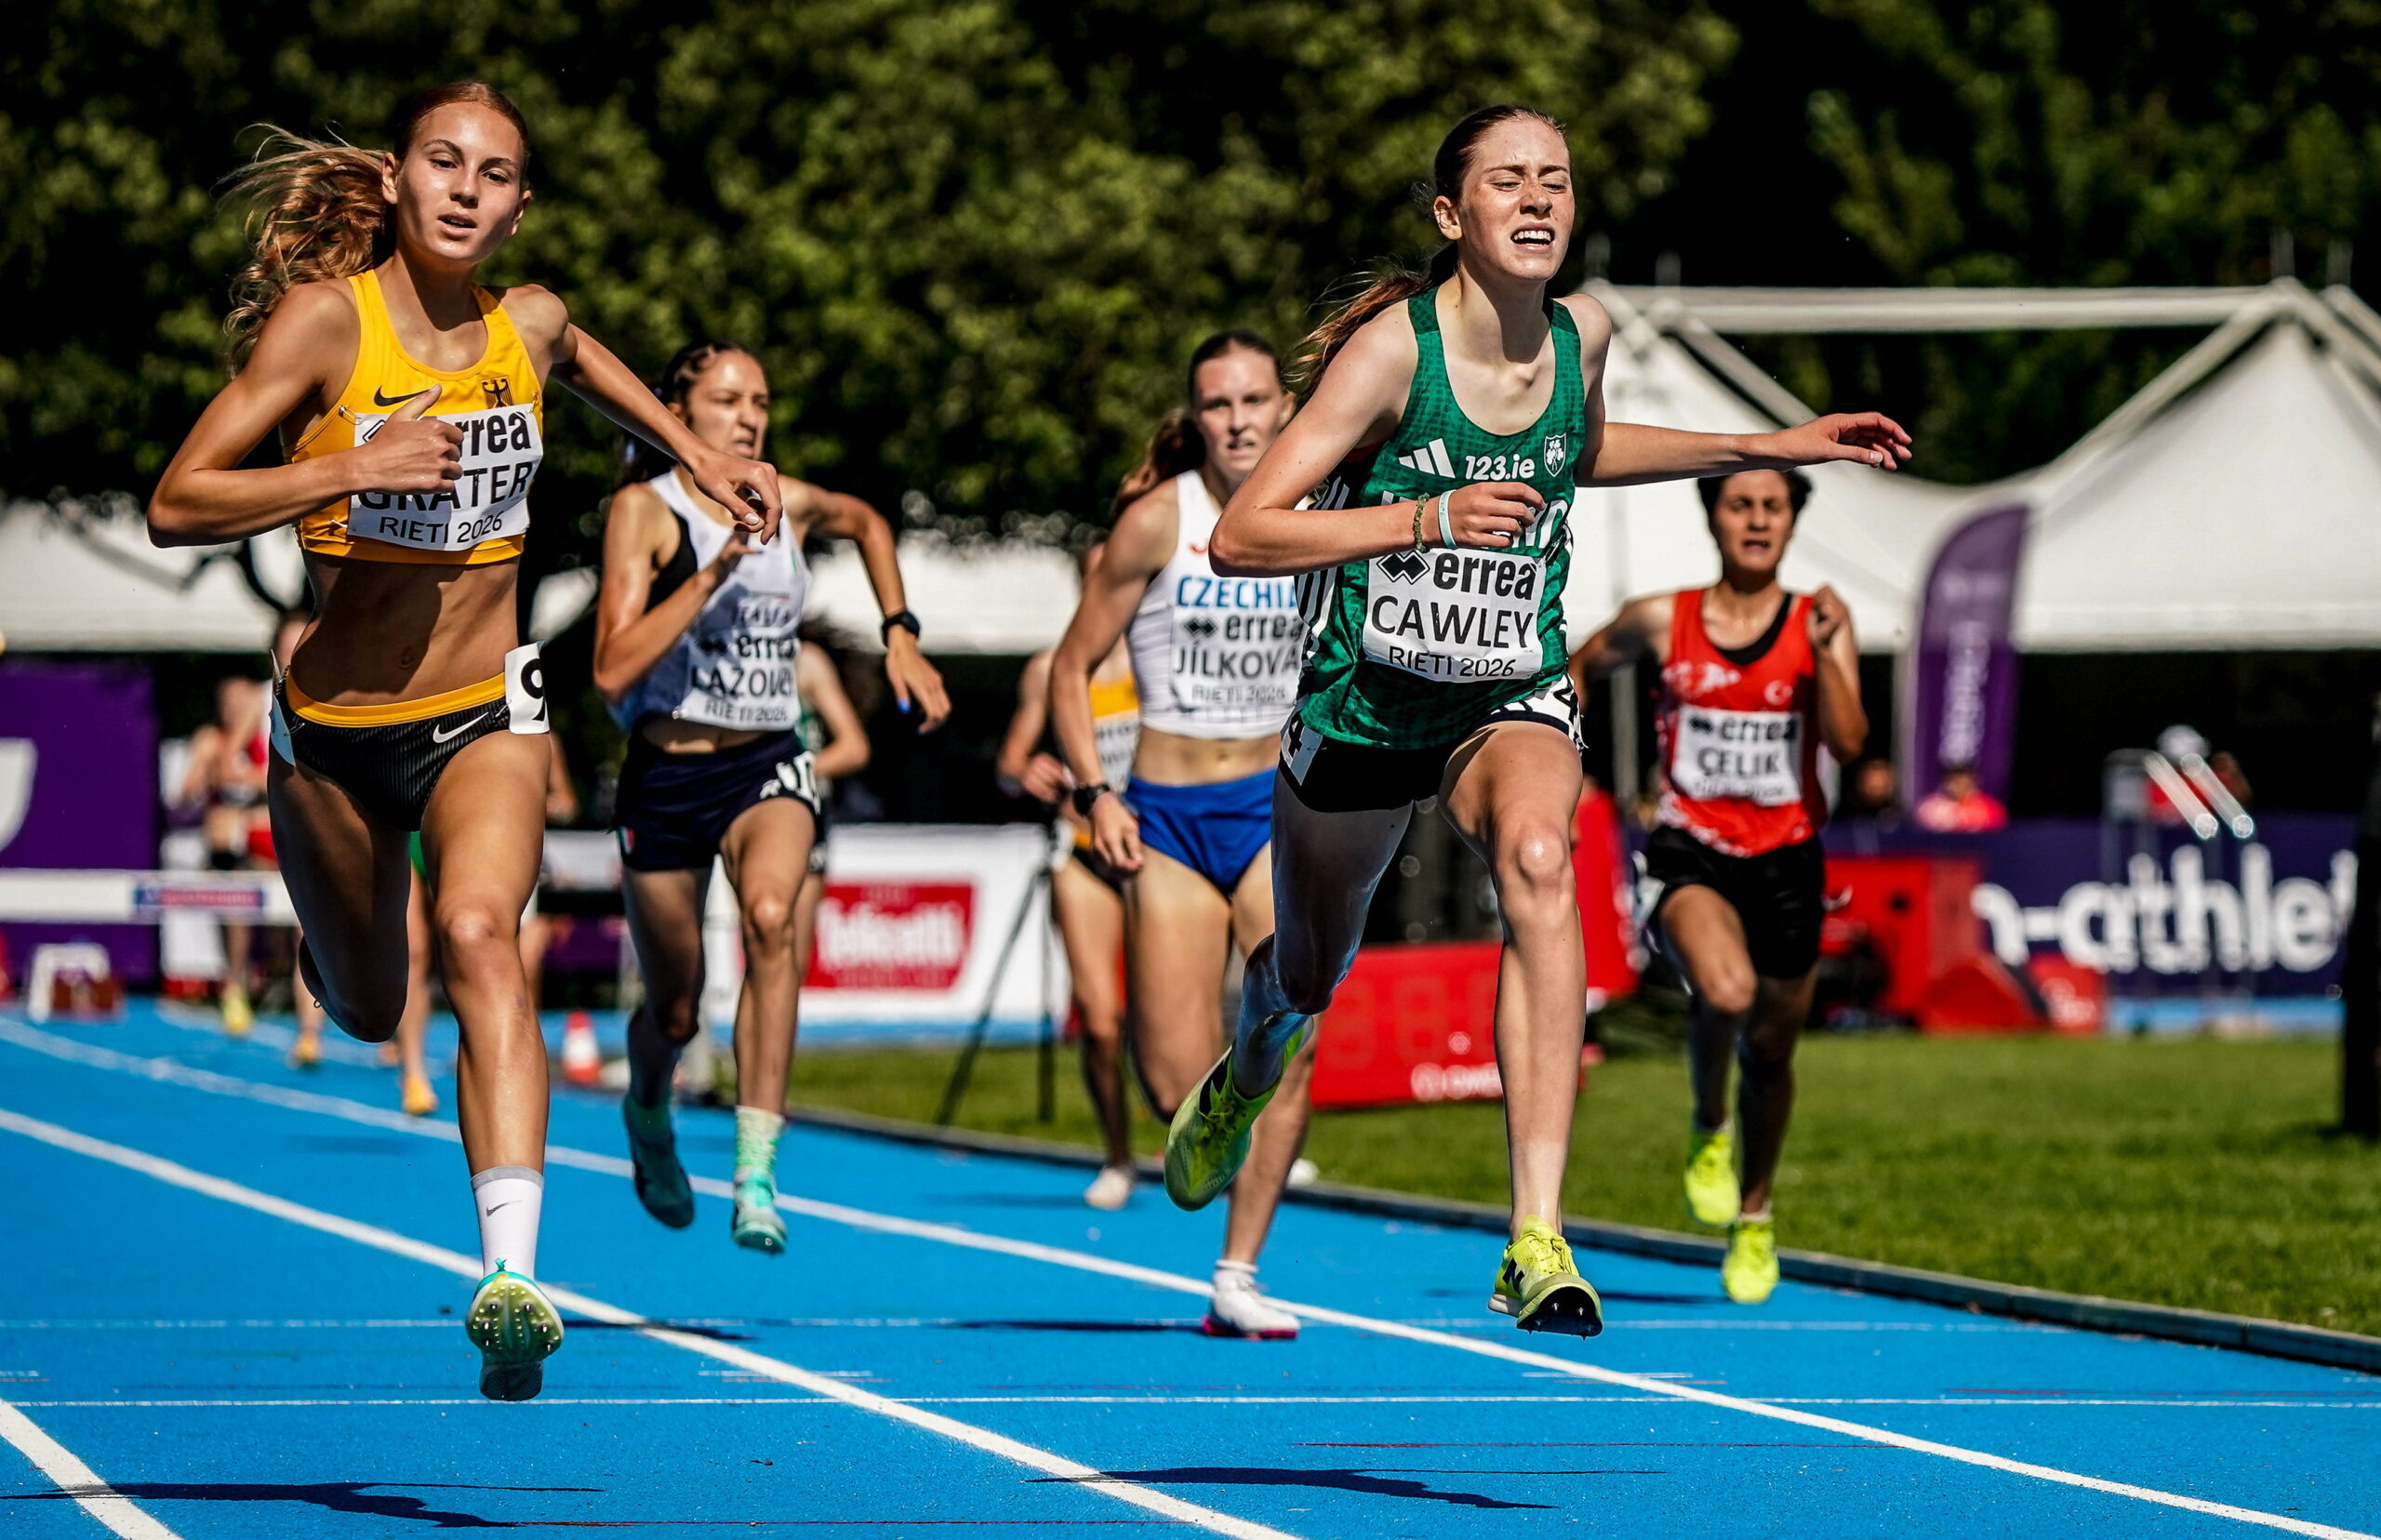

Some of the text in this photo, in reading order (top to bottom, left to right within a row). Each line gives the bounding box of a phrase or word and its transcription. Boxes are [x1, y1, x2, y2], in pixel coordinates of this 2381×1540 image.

[1465, 454, 1535, 481] 123.ie
[379, 511, 504, 544] RIETI 2026
[1371, 595, 1534, 649] CAWLEY
[1389, 646, 1516, 678] RIETI 2026
[521, 658, 546, 722] 9
